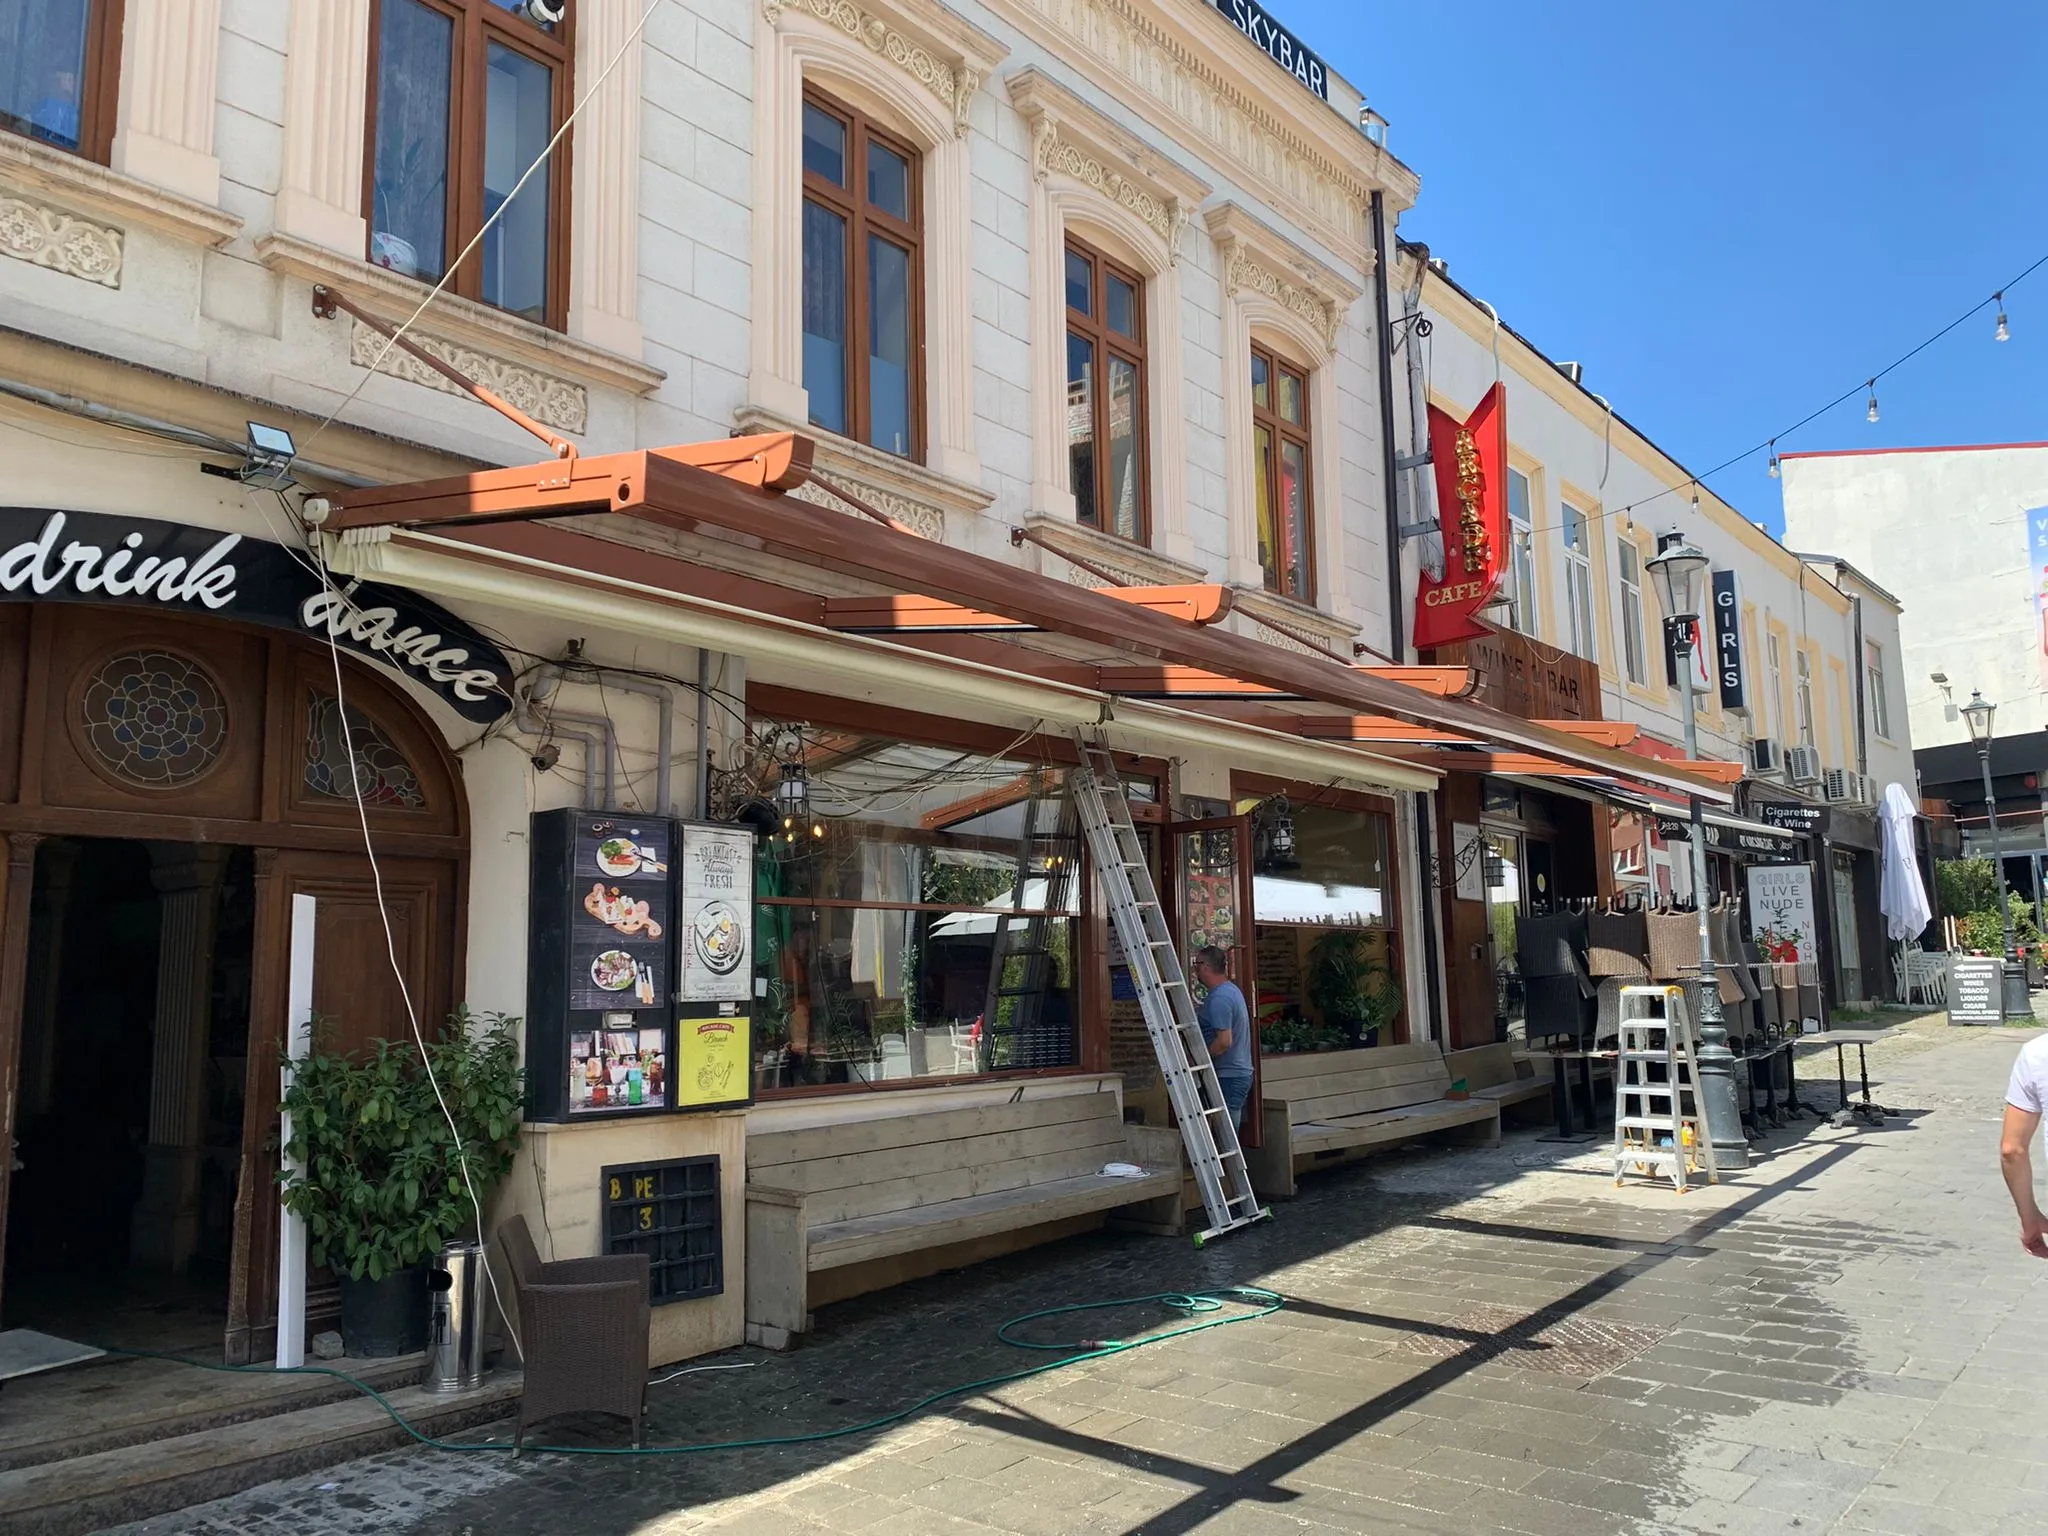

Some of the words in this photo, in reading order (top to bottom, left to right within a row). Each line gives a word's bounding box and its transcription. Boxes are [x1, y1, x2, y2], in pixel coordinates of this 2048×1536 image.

[1231, 0, 1323, 98] SKYBAR
[1455, 428, 1485, 572] ARCADE
[1425, 580, 1483, 607] CAFE
[0, 511, 242, 610] drink
[303, 577, 499, 703] dance
[1717, 591, 1739, 687] GIRLS
[1476, 644, 1524, 681] WINE
[1547, 669, 1579, 700] BAR
[1766, 806, 1820, 818] Cigarettes
[1773, 819, 1782, 827] &
[1784, 819, 1812, 829] Wine
[704, 874, 733, 889] FRESH
[1755, 873, 1806, 885] GIRLS
[1762, 885, 1800, 897] LIVE
[1760, 898, 1804, 910] NUDE
[608, 1178, 622, 1200] B
[635, 1176, 654, 1199] PE
[639, 1206, 653, 1230] 3
